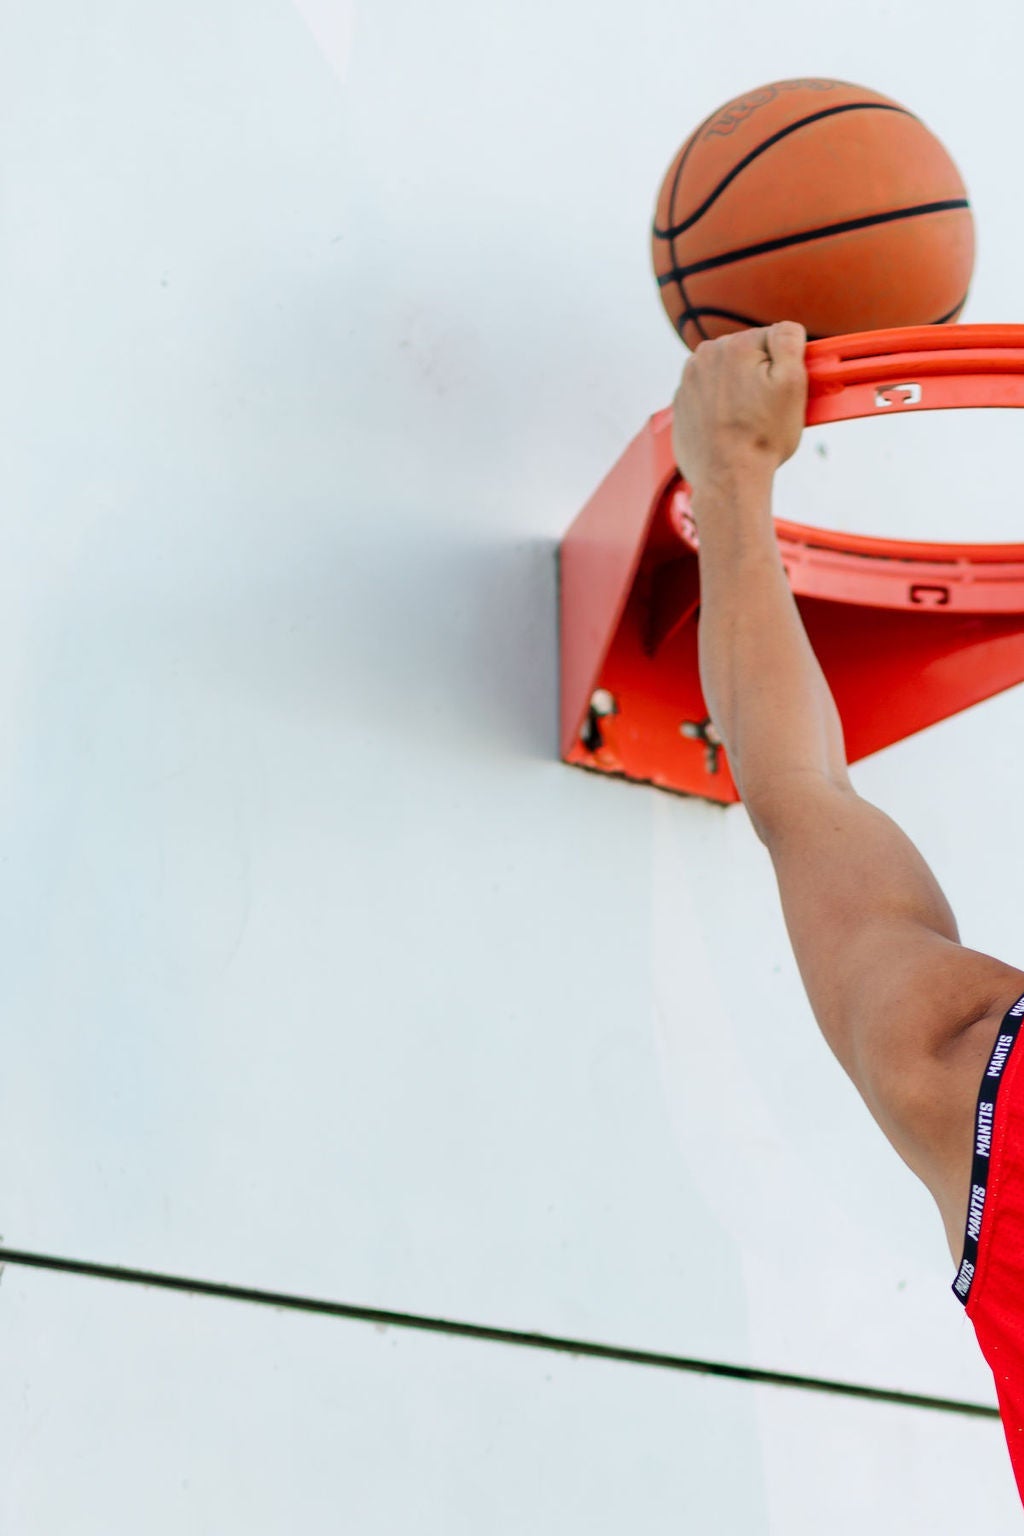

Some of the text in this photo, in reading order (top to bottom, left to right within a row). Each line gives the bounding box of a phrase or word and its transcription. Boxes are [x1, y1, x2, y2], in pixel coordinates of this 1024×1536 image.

[986, 1035, 1013, 1077] MANTIS
[976, 1102, 994, 1158] MANTIS
[967, 1184, 986, 1242] MANTIS
